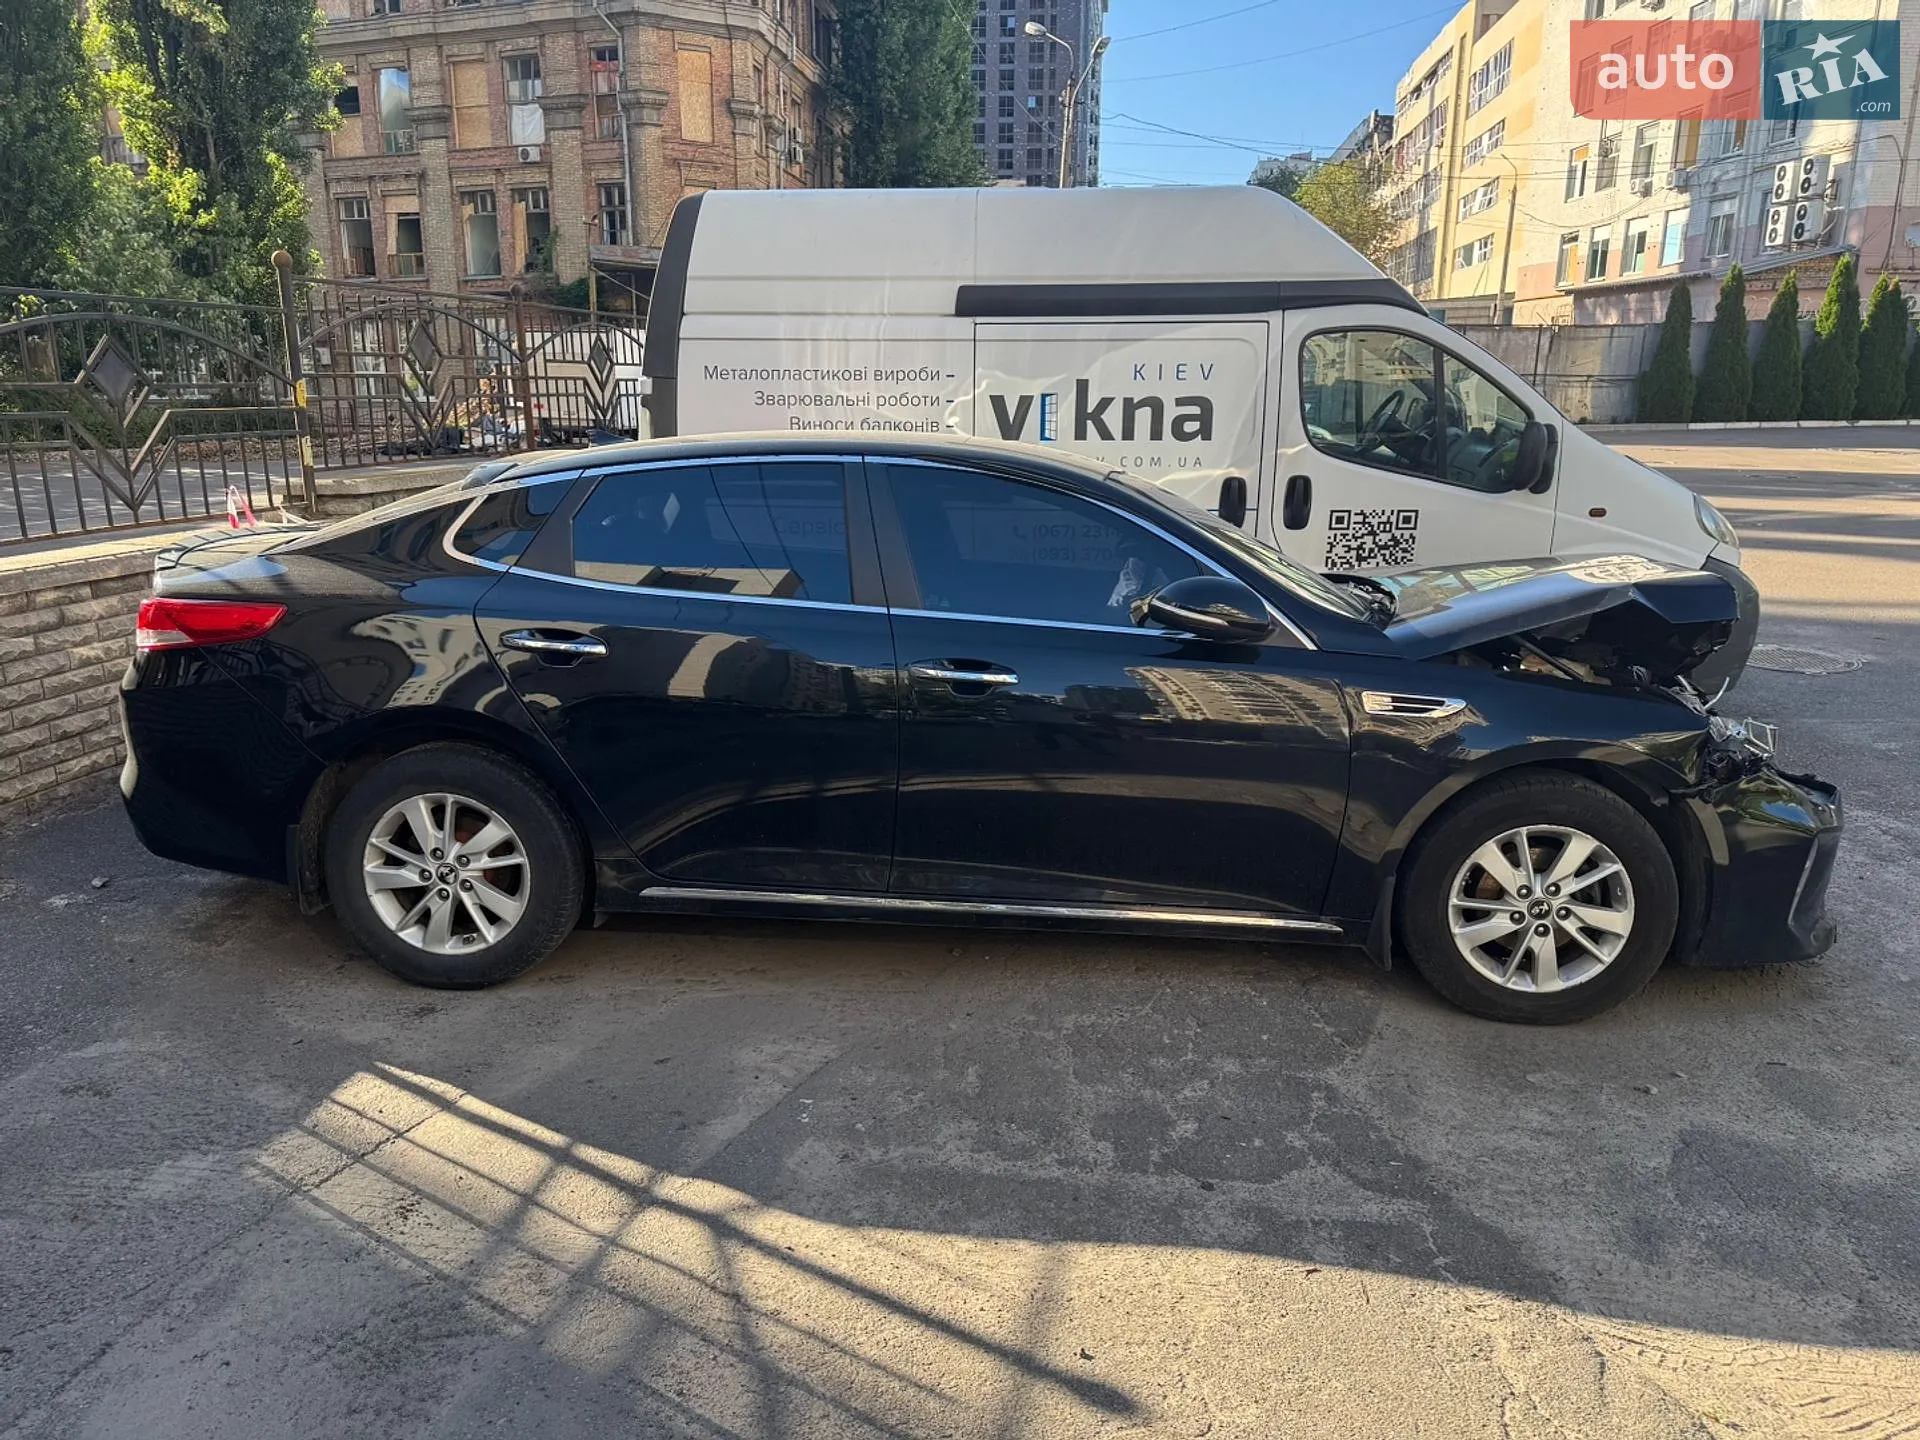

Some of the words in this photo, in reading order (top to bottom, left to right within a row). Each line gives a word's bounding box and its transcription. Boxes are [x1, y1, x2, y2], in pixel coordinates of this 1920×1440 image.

[703, 365, 867, 381] Металопластикові
[874, 366, 940, 385] вироби
[1133, 363, 1214, 381] KIEV
[754, 390, 870, 409] Зварювальні
[876, 391, 940, 409] роботи
[789, 416, 854, 431] Виноси
[861, 417, 940, 432] балконів
